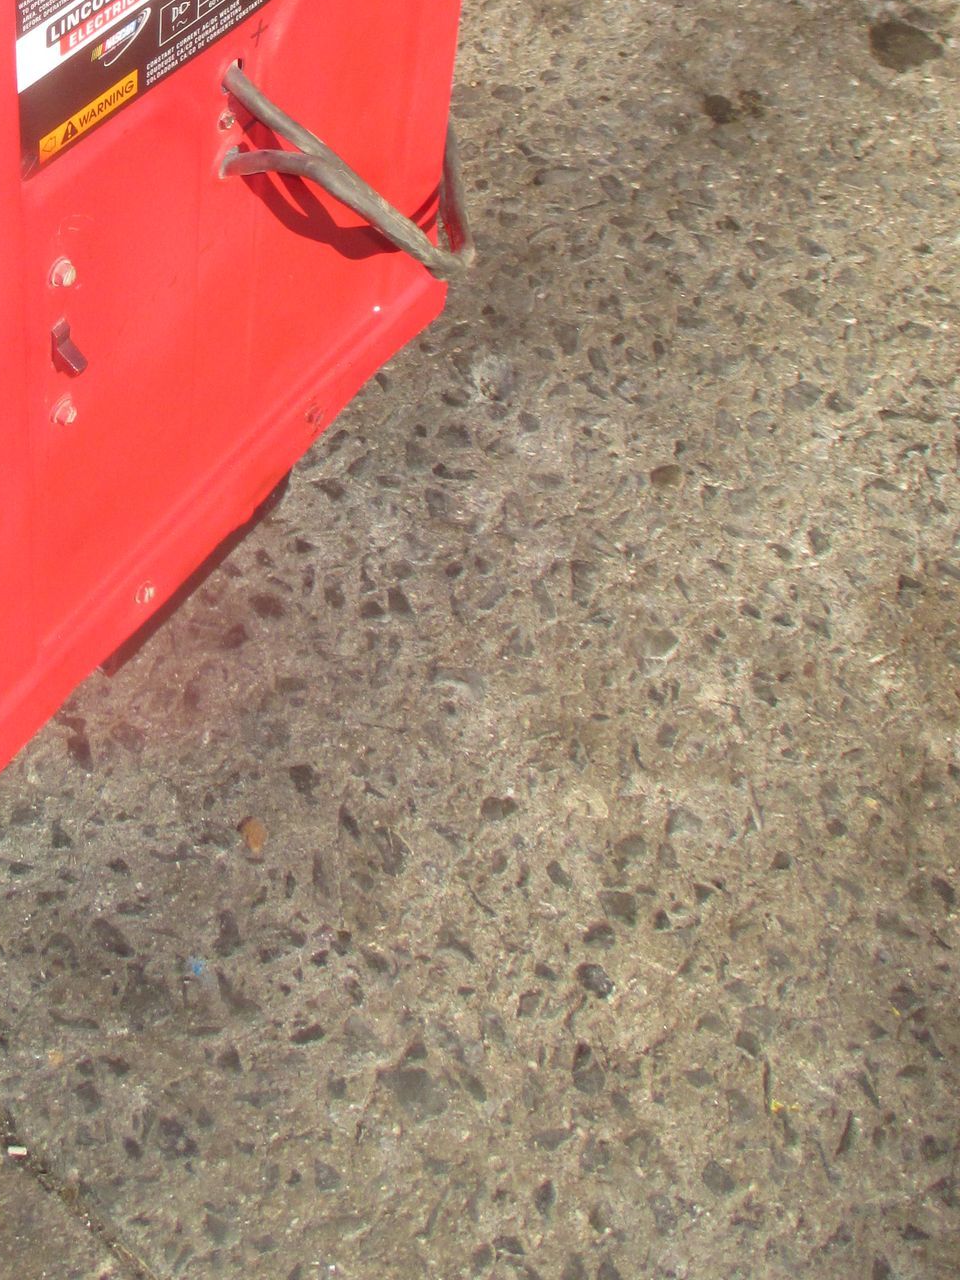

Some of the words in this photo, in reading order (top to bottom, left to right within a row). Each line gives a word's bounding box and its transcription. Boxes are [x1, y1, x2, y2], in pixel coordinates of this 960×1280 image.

[146, 52, 174, 82] SOUDEUSE
[194, 22, 218, 45] COURANT
[220, 4, 242, 26] CONTINU
[146, 44, 174, 74] CONSTANT
[176, 26, 200, 50] CURRENT
[146, 56, 178, 88] SOLDADORA
[198, 39, 204, 50] DE
[206, 16, 234, 44] CORRIENTE
[79, 77, 134, 130] WARNING
